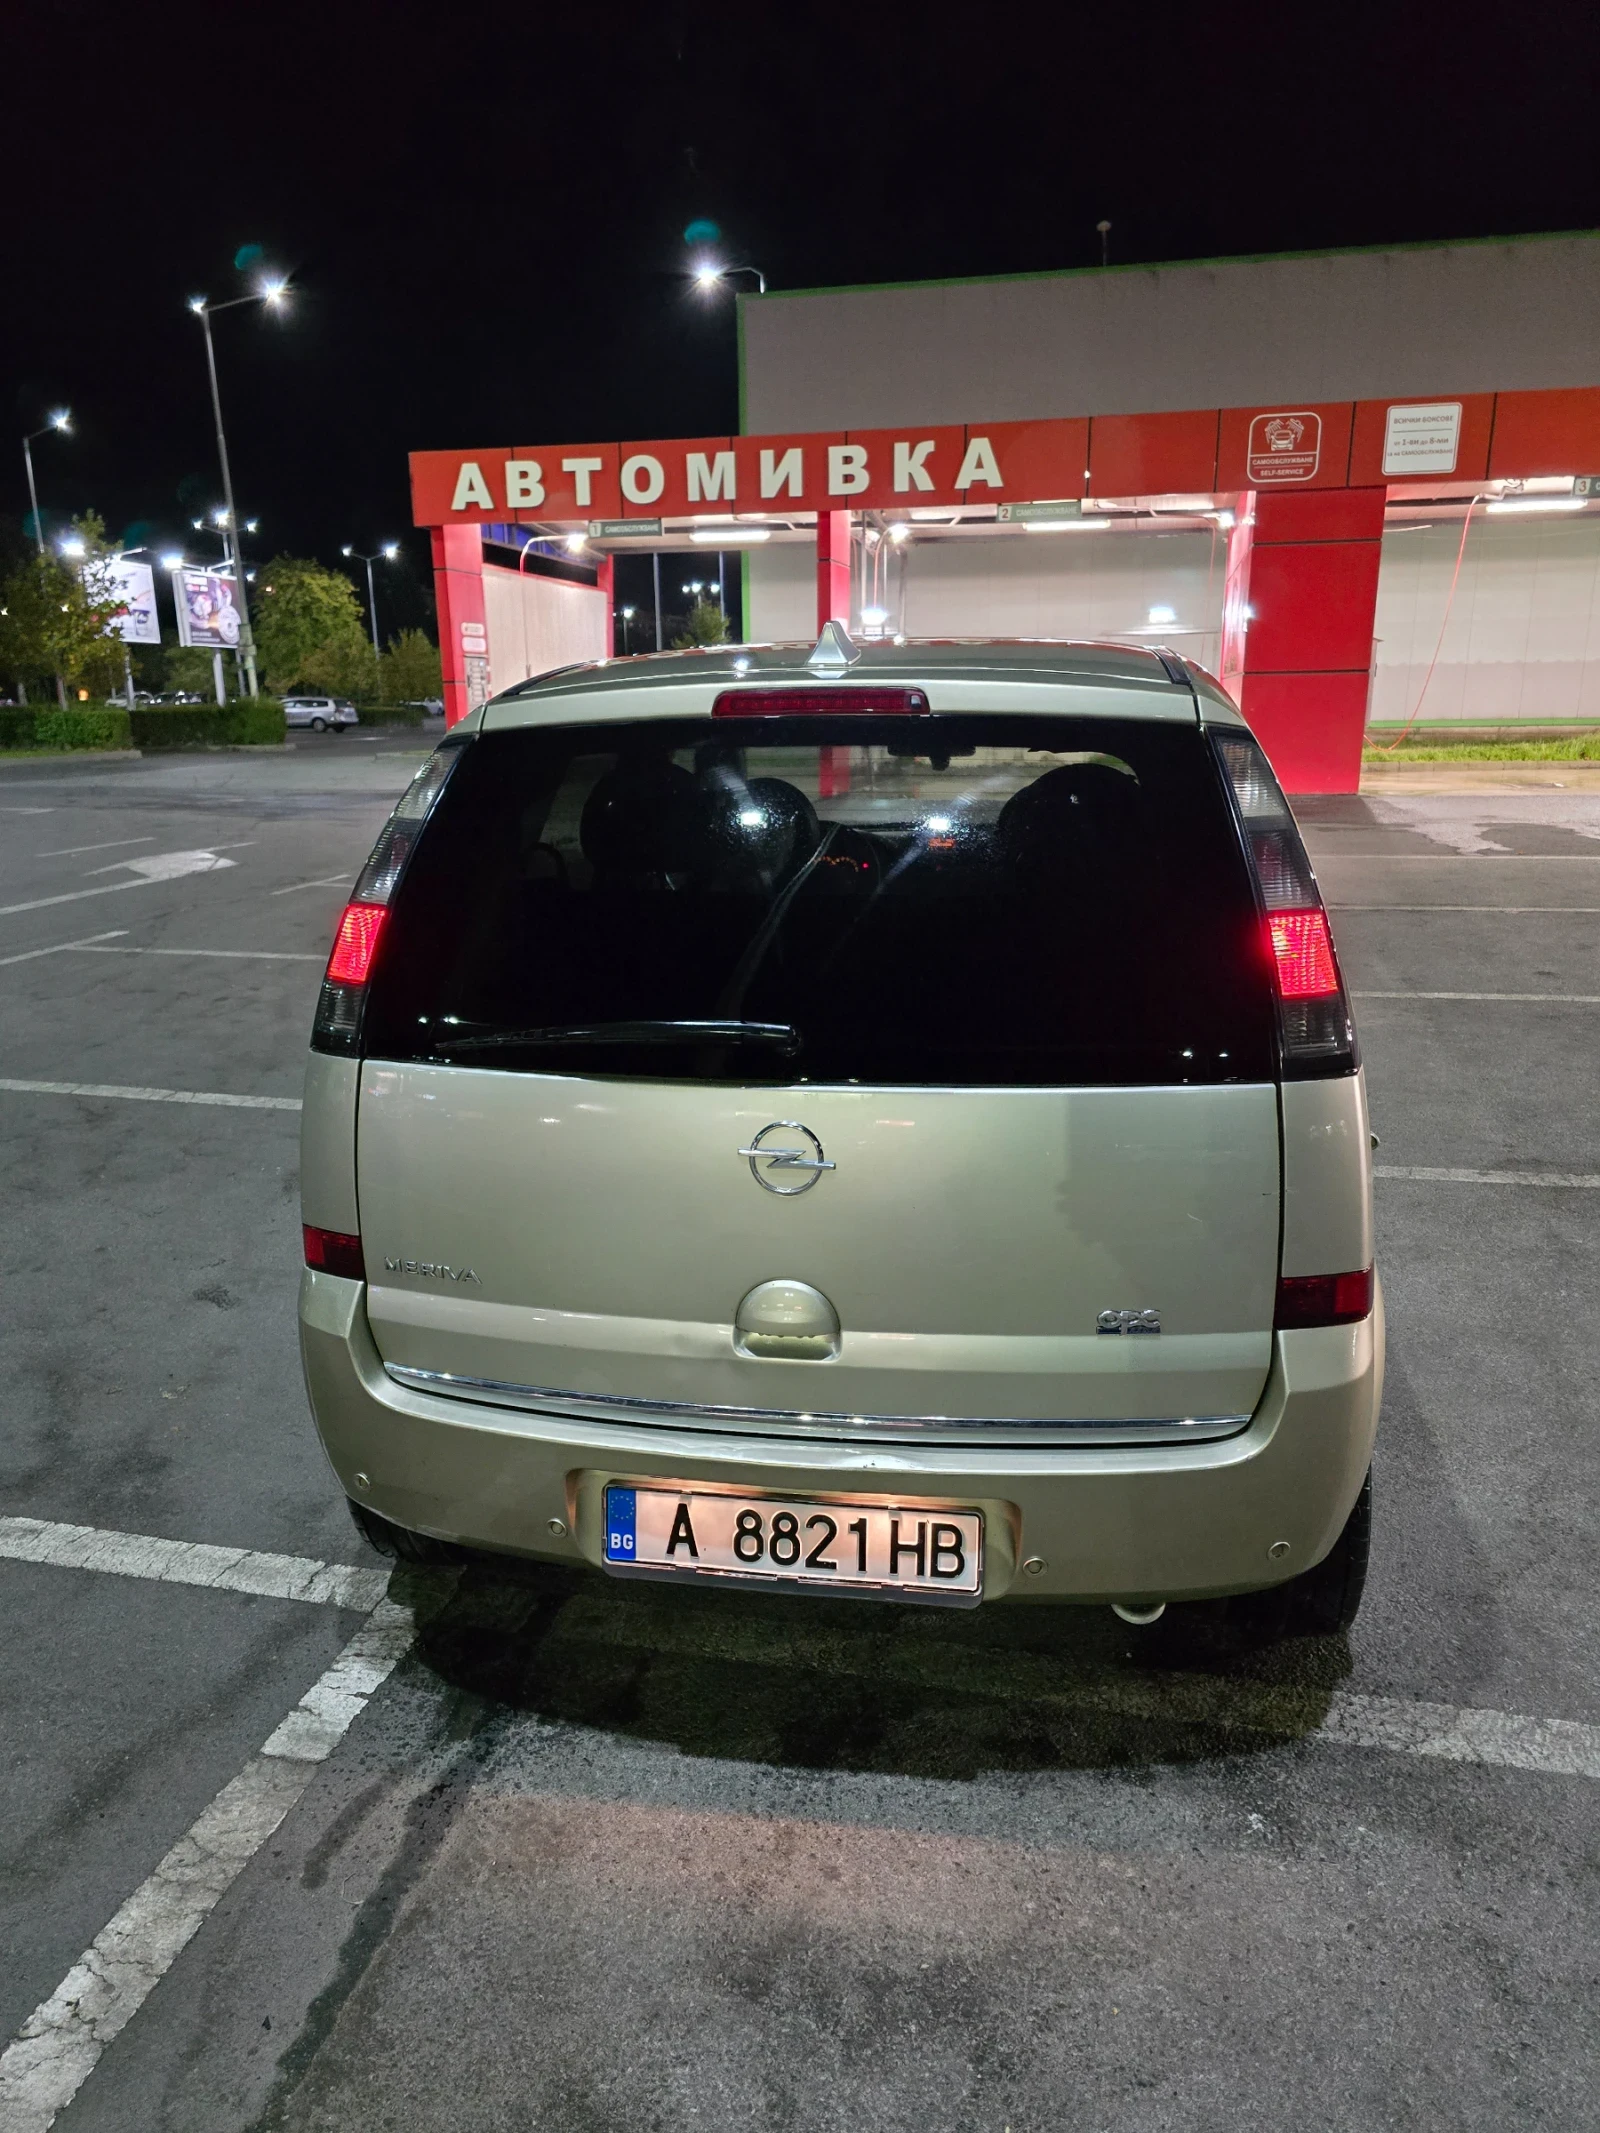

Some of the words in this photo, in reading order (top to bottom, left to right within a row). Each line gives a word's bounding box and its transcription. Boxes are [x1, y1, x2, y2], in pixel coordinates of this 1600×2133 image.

[1252, 456, 1314, 466] САМООБСЛУЖВАНЕ
[451, 437, 1004, 511] АВТОМИВКА
[1260, 468, 1304, 477] SELF-SERVICE
[1579, 480, 1587, 492] 3
[1002, 508, 1009, 519] 2
[384, 1256, 483, 1285] MERIVA
[610, 1533, 634, 1550] BG
[666, 1503, 699, 1558] A
[733, 1508, 868, 1572] 8821
[889, 1519, 966, 1579] HB
